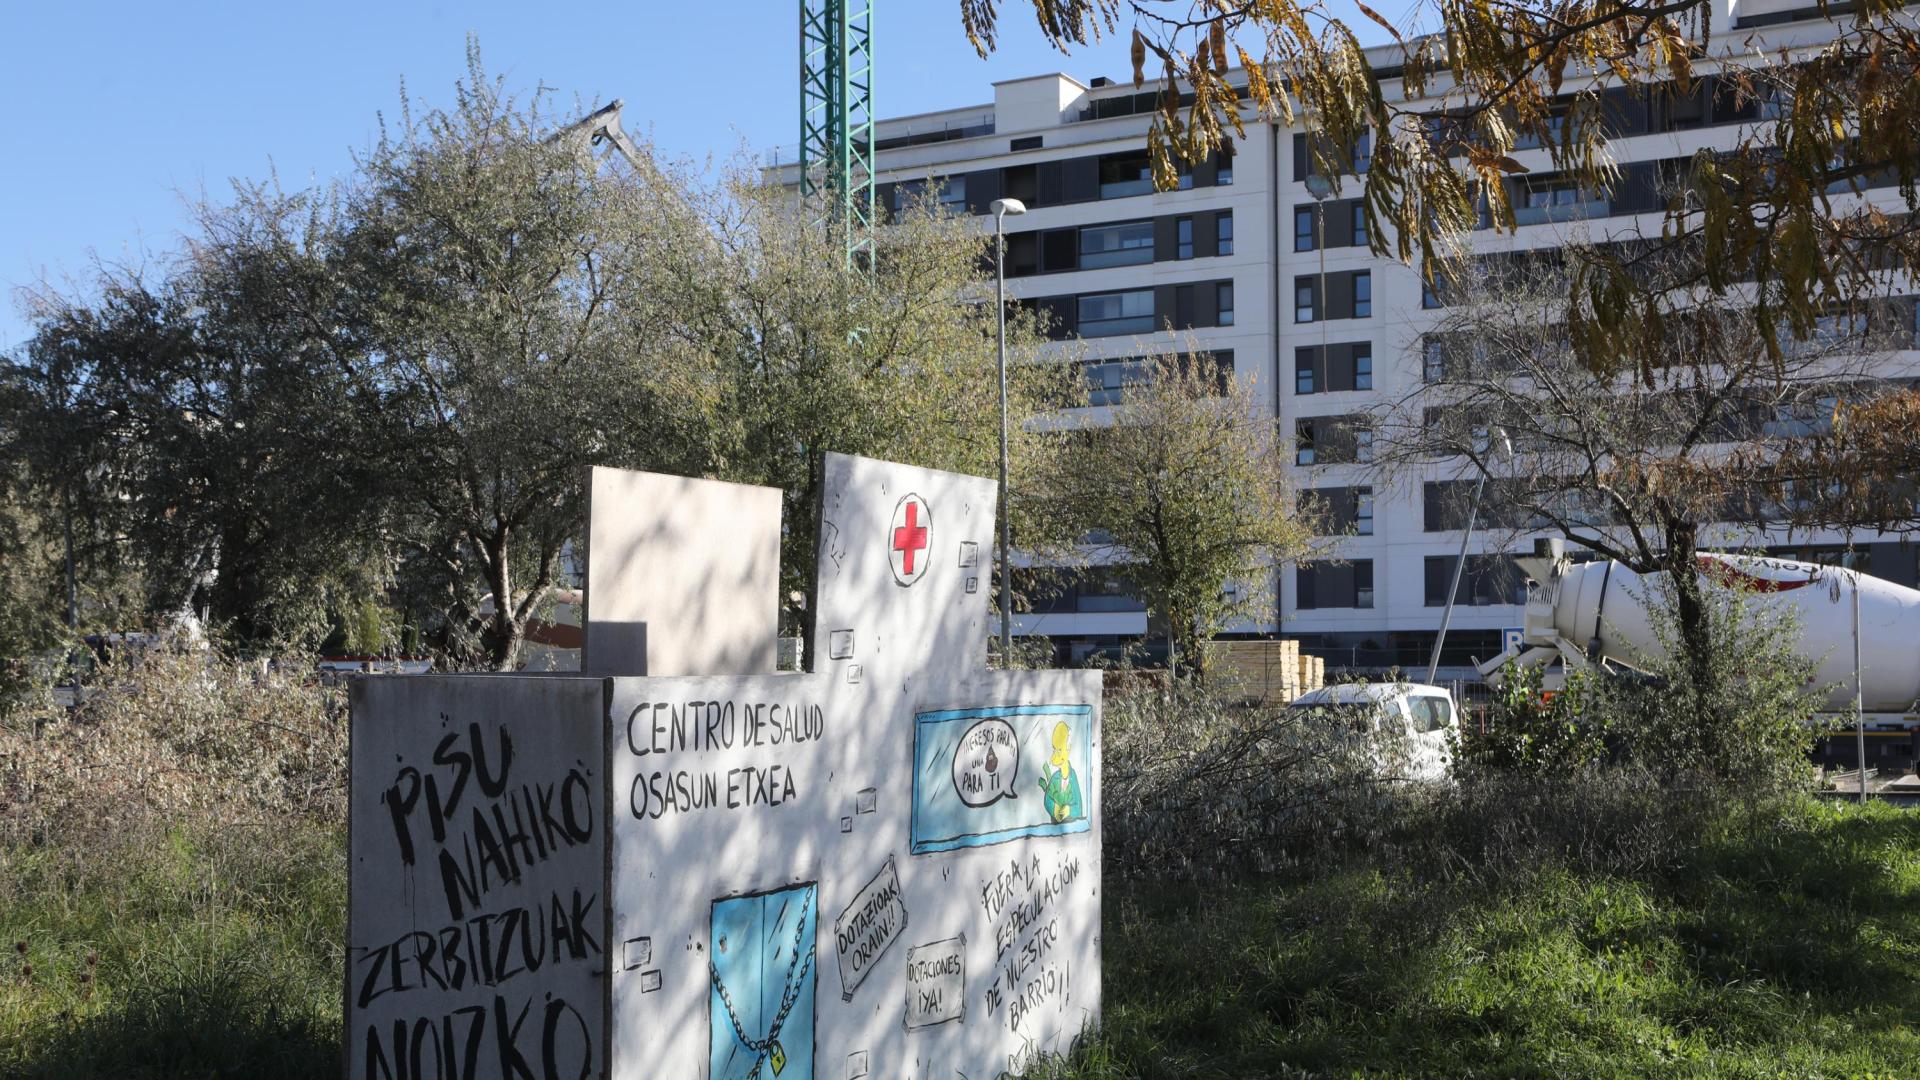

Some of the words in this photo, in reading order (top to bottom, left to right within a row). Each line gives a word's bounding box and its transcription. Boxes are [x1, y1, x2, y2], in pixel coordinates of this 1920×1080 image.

[627, 700, 735, 756] CENTRO
[769, 703, 824, 745] SALUD
[384, 722, 514, 866] PISU
[630, 771, 717, 820] OSASUN
[727, 764, 796, 809] ETXEA
[962, 772, 984, 795] PARA
[989, 771, 1000, 791] TI
[438, 768, 593, 921] NAHIKO
[838, 877, 897, 955] DOTAZIOAK
[982, 859, 1022, 923] FUERA
[1025, 852, 1040, 892] LA
[356, 888, 602, 1009] ZERBITZUAK
[852, 904, 895, 972] ORAIN!!
[908, 953, 961, 984] DOTACIONES
[986, 976, 1002, 1018] DE
[1006, 919, 1057, 992] NUESTRO
[918, 986, 943, 1015] ¡YA!
